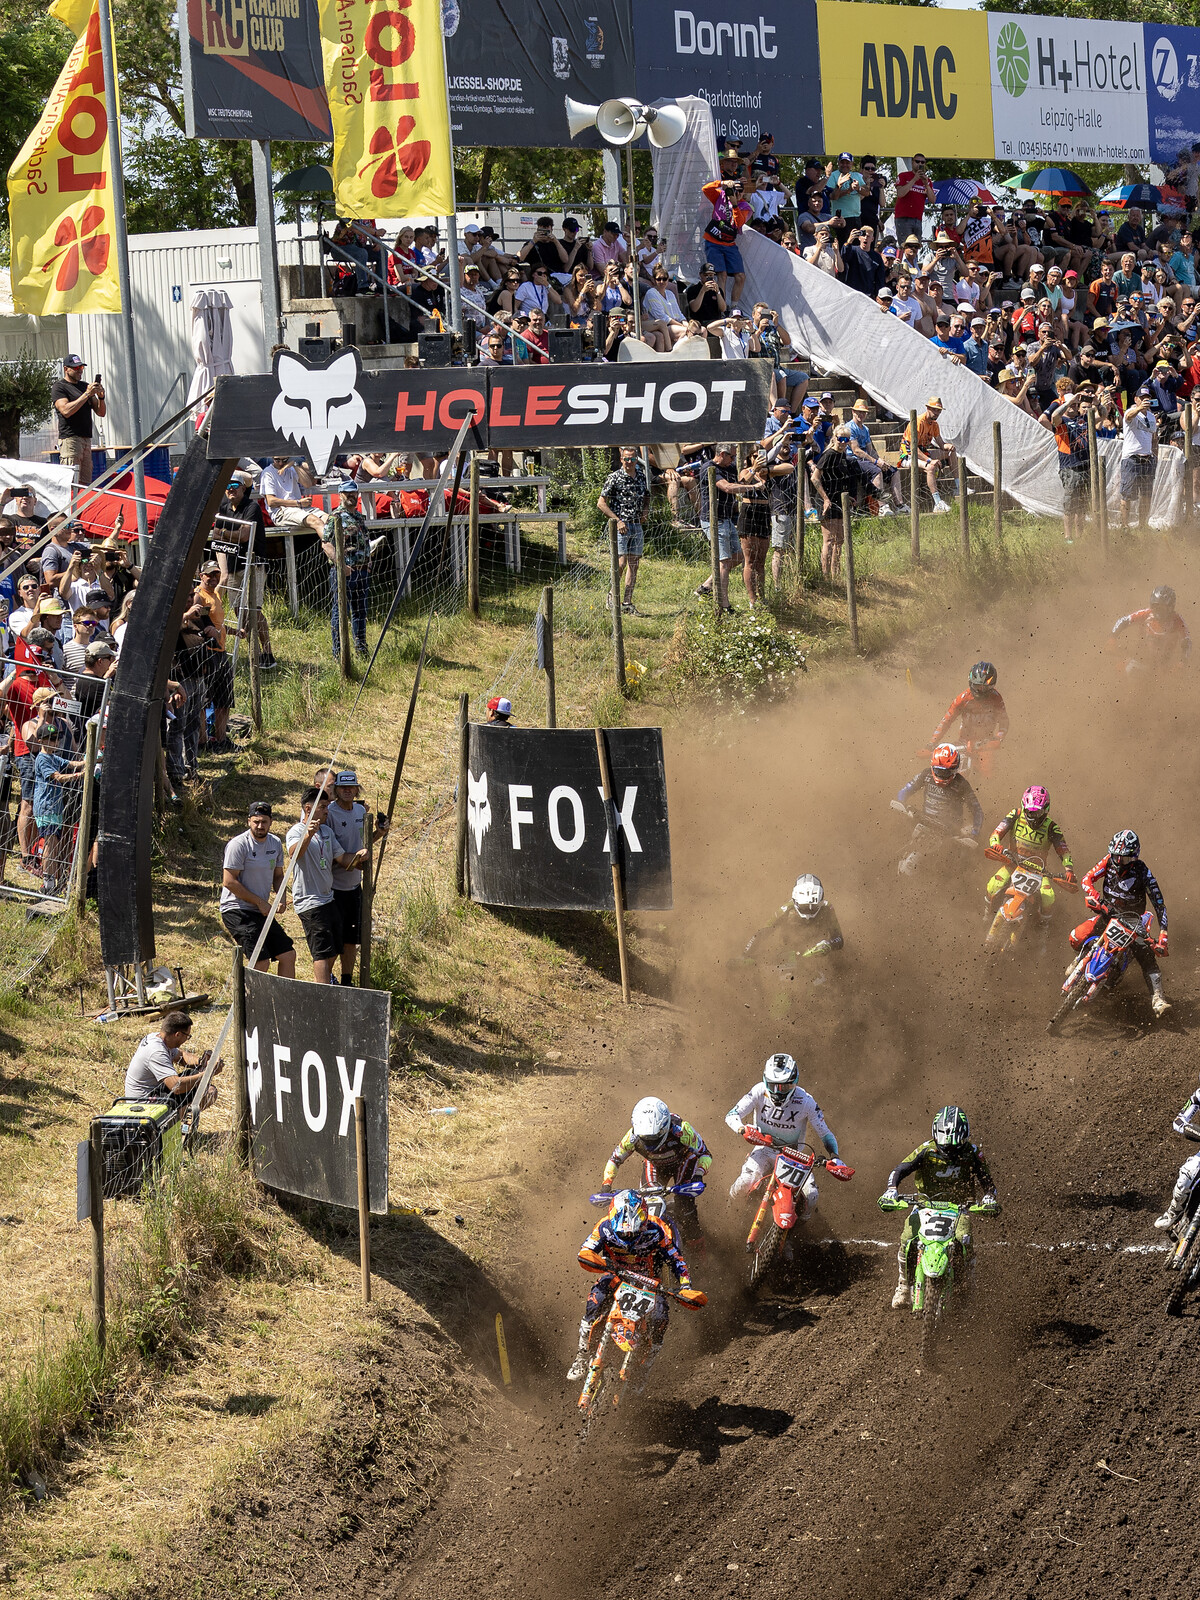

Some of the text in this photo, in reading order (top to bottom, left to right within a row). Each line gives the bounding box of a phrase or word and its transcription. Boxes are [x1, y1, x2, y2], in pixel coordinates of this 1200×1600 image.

[250, 17, 285, 52] CLUB
[674, 10, 778, 59] Dorint
[448, 76, 523, 91] LKESSEL-SHOP.DE
[860, 43, 958, 120] ADAC
[697, 88, 762, 109] Charlottenhof
[714, 118, 727, 138] lle
[1040, 106, 1103, 131] Leipzig-Halle
[1002, 141, 1015, 156] Tel.
[1018, 140, 1068, 158] (0345)56470
[1077, 145, 1145, 159] www.h-hotels.com
[394, 380, 746, 432] HOLESHOT
[508, 784, 643, 853] FOX
[1015, 823, 1045, 844] FXR
[1013, 874, 1040, 894] 29
[272, 1043, 366, 1137] FOX
[761, 1104, 800, 1122] FOX
[761, 1116, 796, 1130] HONDA
[777, 1164, 806, 1187] 70
[924, 1216, 954, 1237] 3
[619, 1292, 651, 1317] 84
